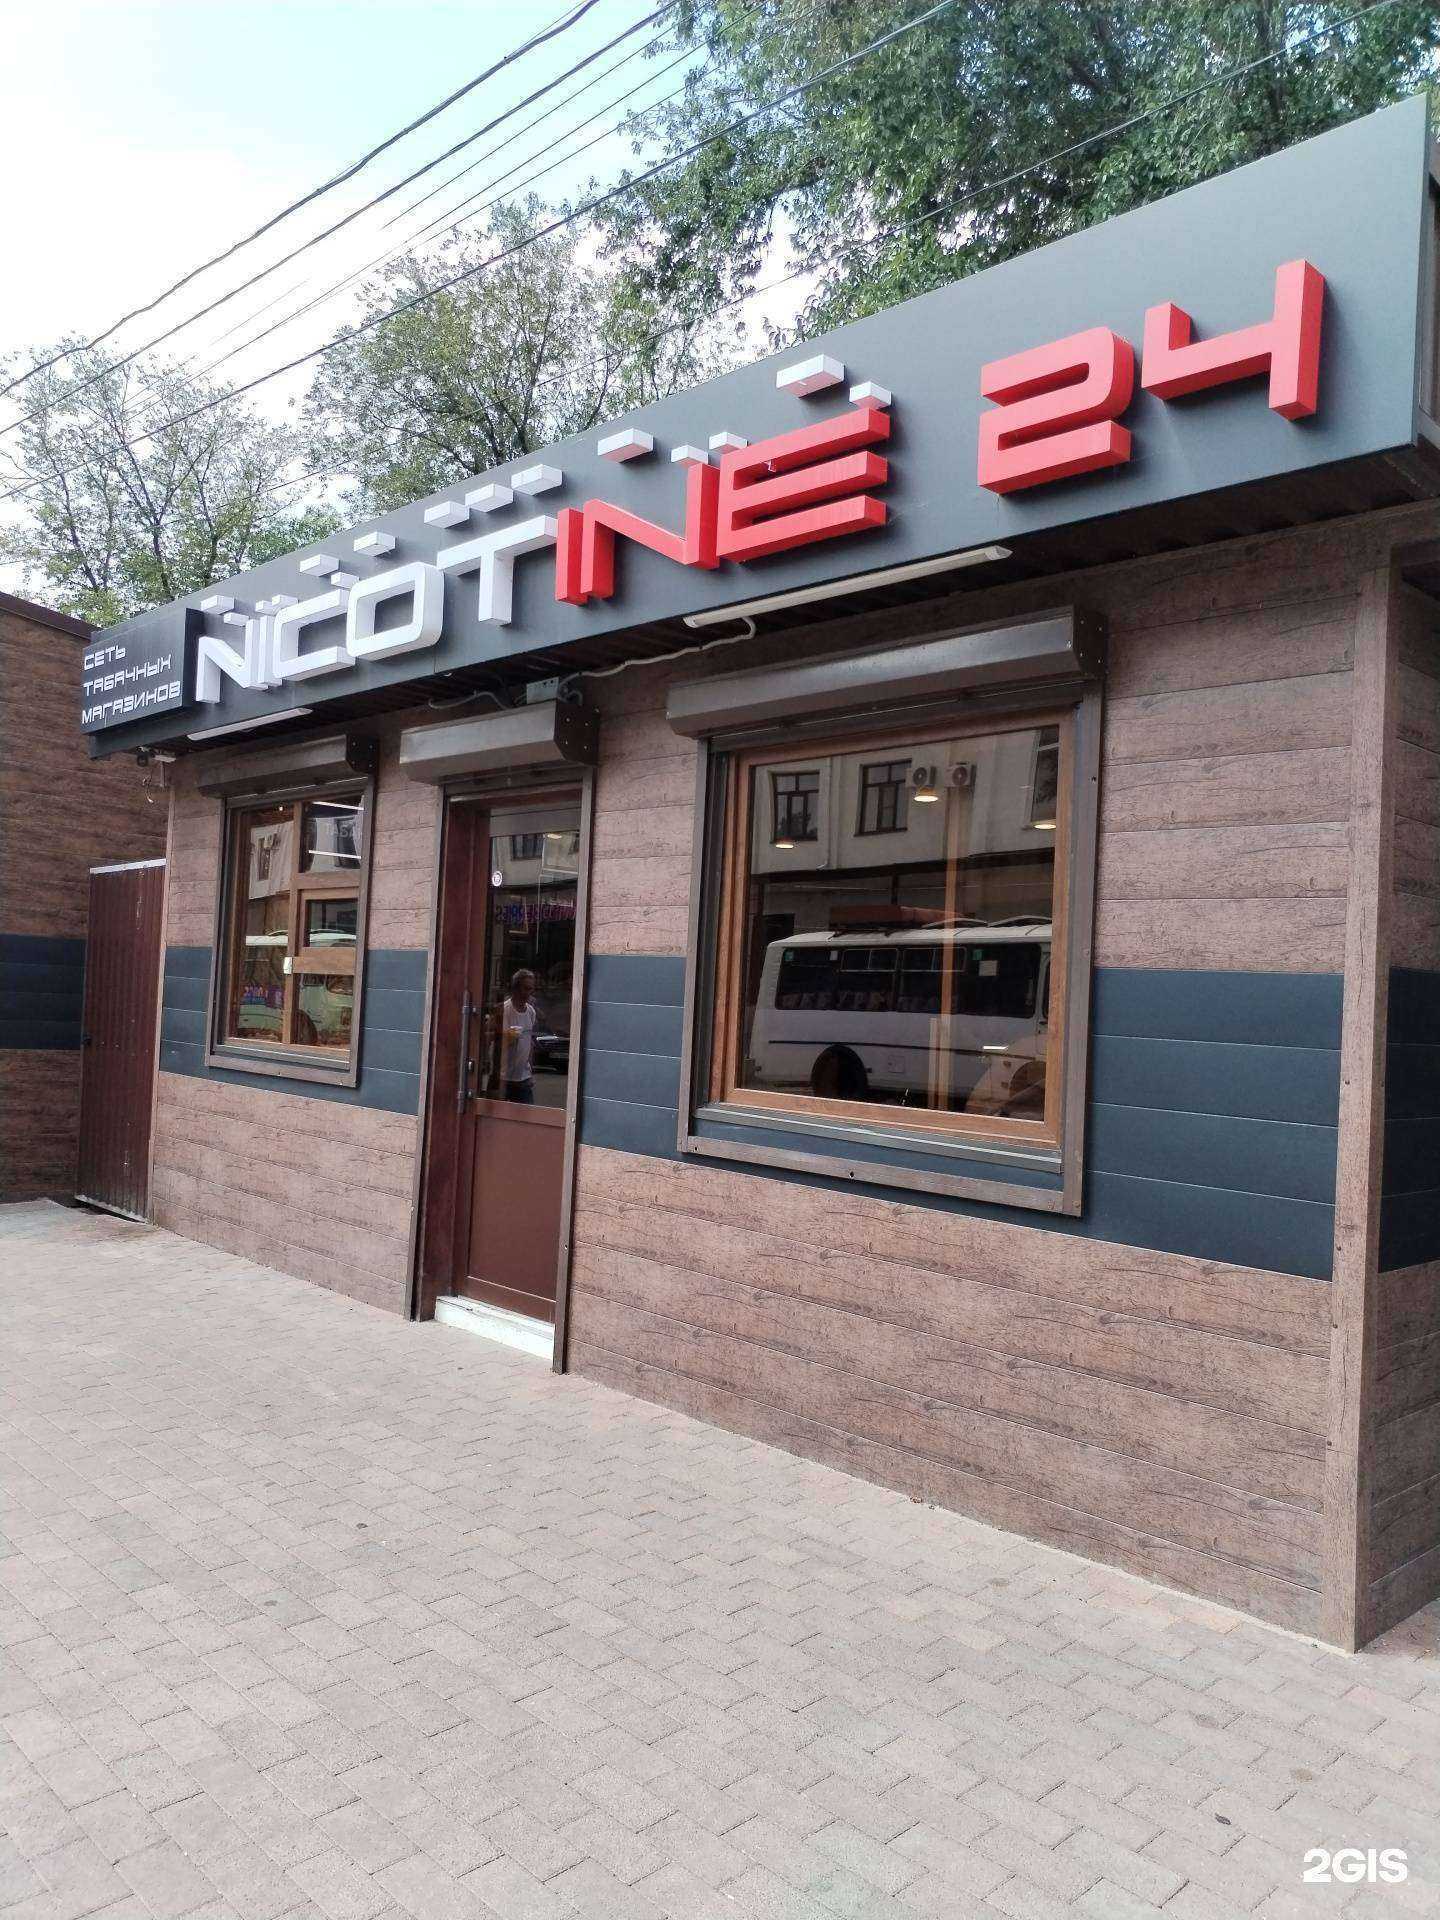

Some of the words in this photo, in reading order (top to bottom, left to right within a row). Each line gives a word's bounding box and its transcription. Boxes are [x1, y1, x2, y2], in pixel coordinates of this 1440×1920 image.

[196, 403, 891, 704] NICOTINE
[978, 258, 1325, 494] 24
[83, 654, 172, 697] ТАБАЧНЫХ
[84, 645, 126, 671] СЕТЬ
[81, 680, 181, 724] МАГАЗИНОВ
